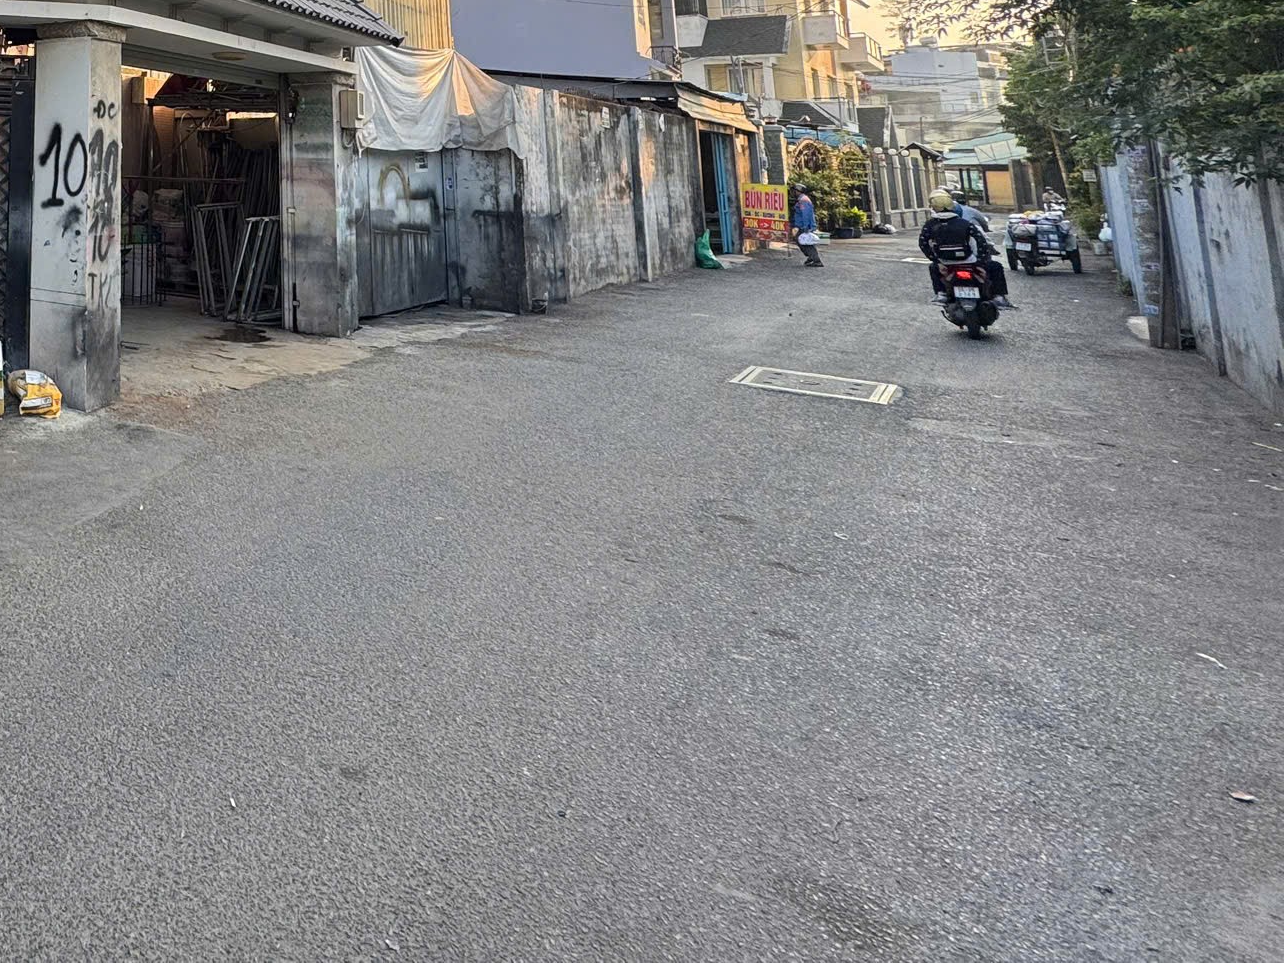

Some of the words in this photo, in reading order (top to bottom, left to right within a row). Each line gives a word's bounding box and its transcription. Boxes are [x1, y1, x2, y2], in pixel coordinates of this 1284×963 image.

[39, 122, 88, 209] 10
[744, 187, 763, 209] BÚN
[764, 188, 785, 211] RIÊU
[743, 218, 759, 228] 30K
[771, 221, 786, 230] 40K
